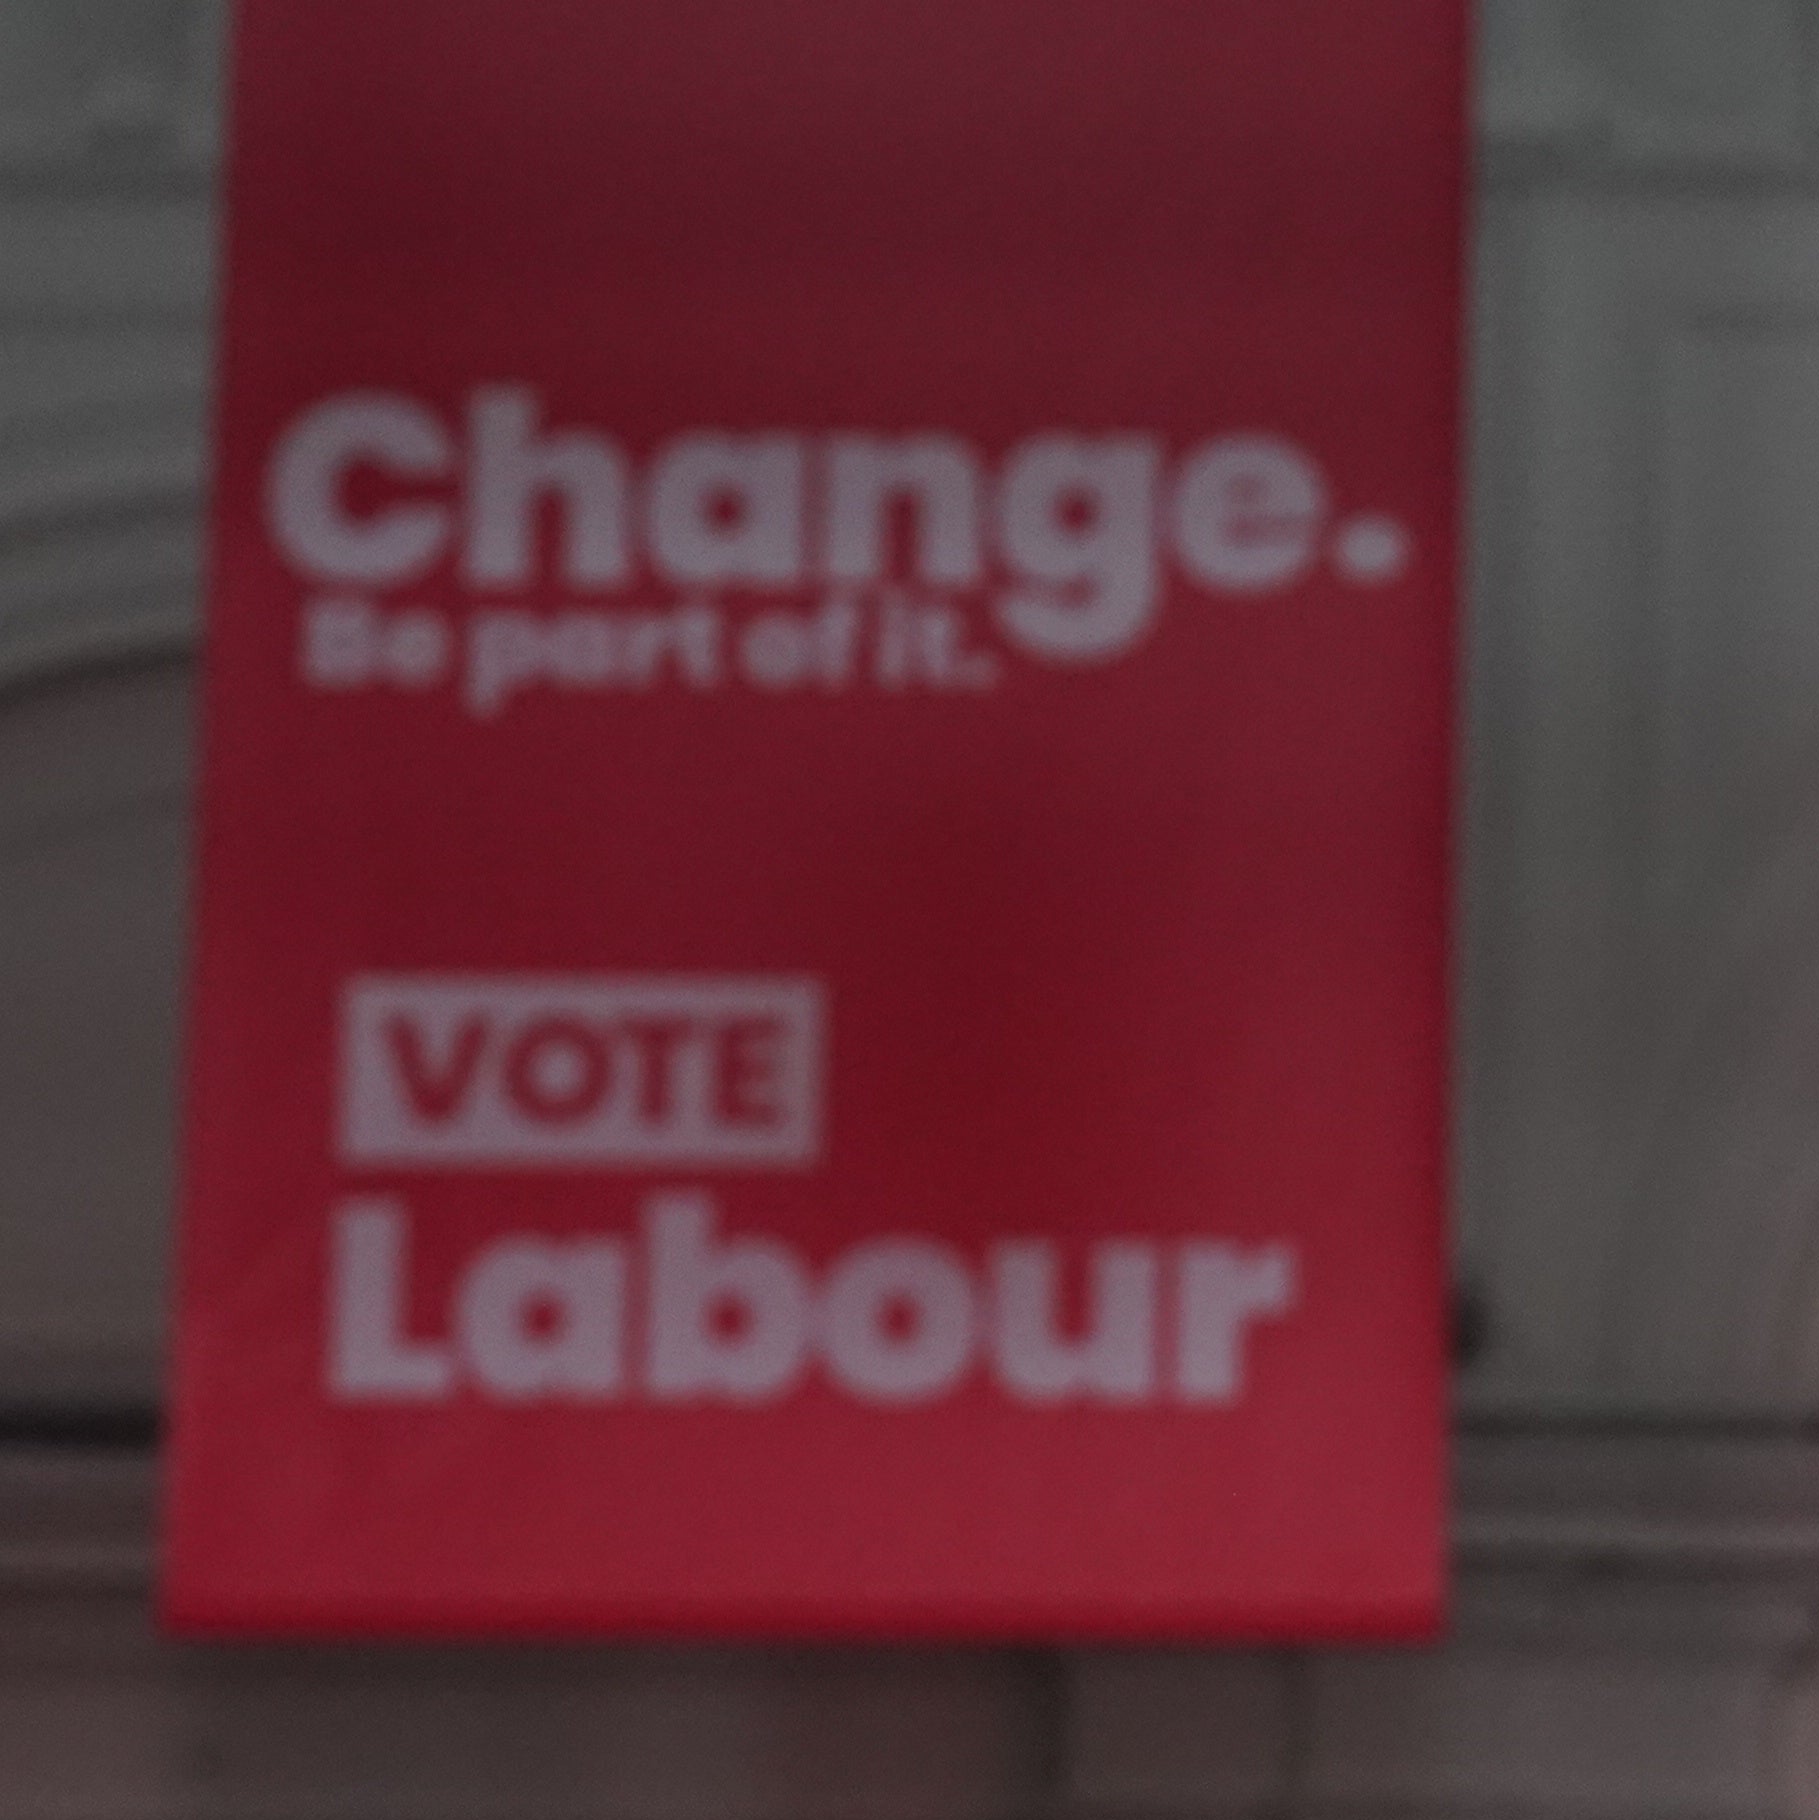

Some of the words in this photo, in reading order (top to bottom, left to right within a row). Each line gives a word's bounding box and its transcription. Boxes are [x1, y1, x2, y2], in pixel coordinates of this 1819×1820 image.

[266, 386, 1408, 658] Change.
[302, 598, 450, 690] Be
[463, 600, 724, 718] part
[737, 592, 864, 688] of
[872, 592, 994, 688] it.
[383, 1011, 788, 1131] VOTE
[325, 1192, 1299, 1408] Labour
